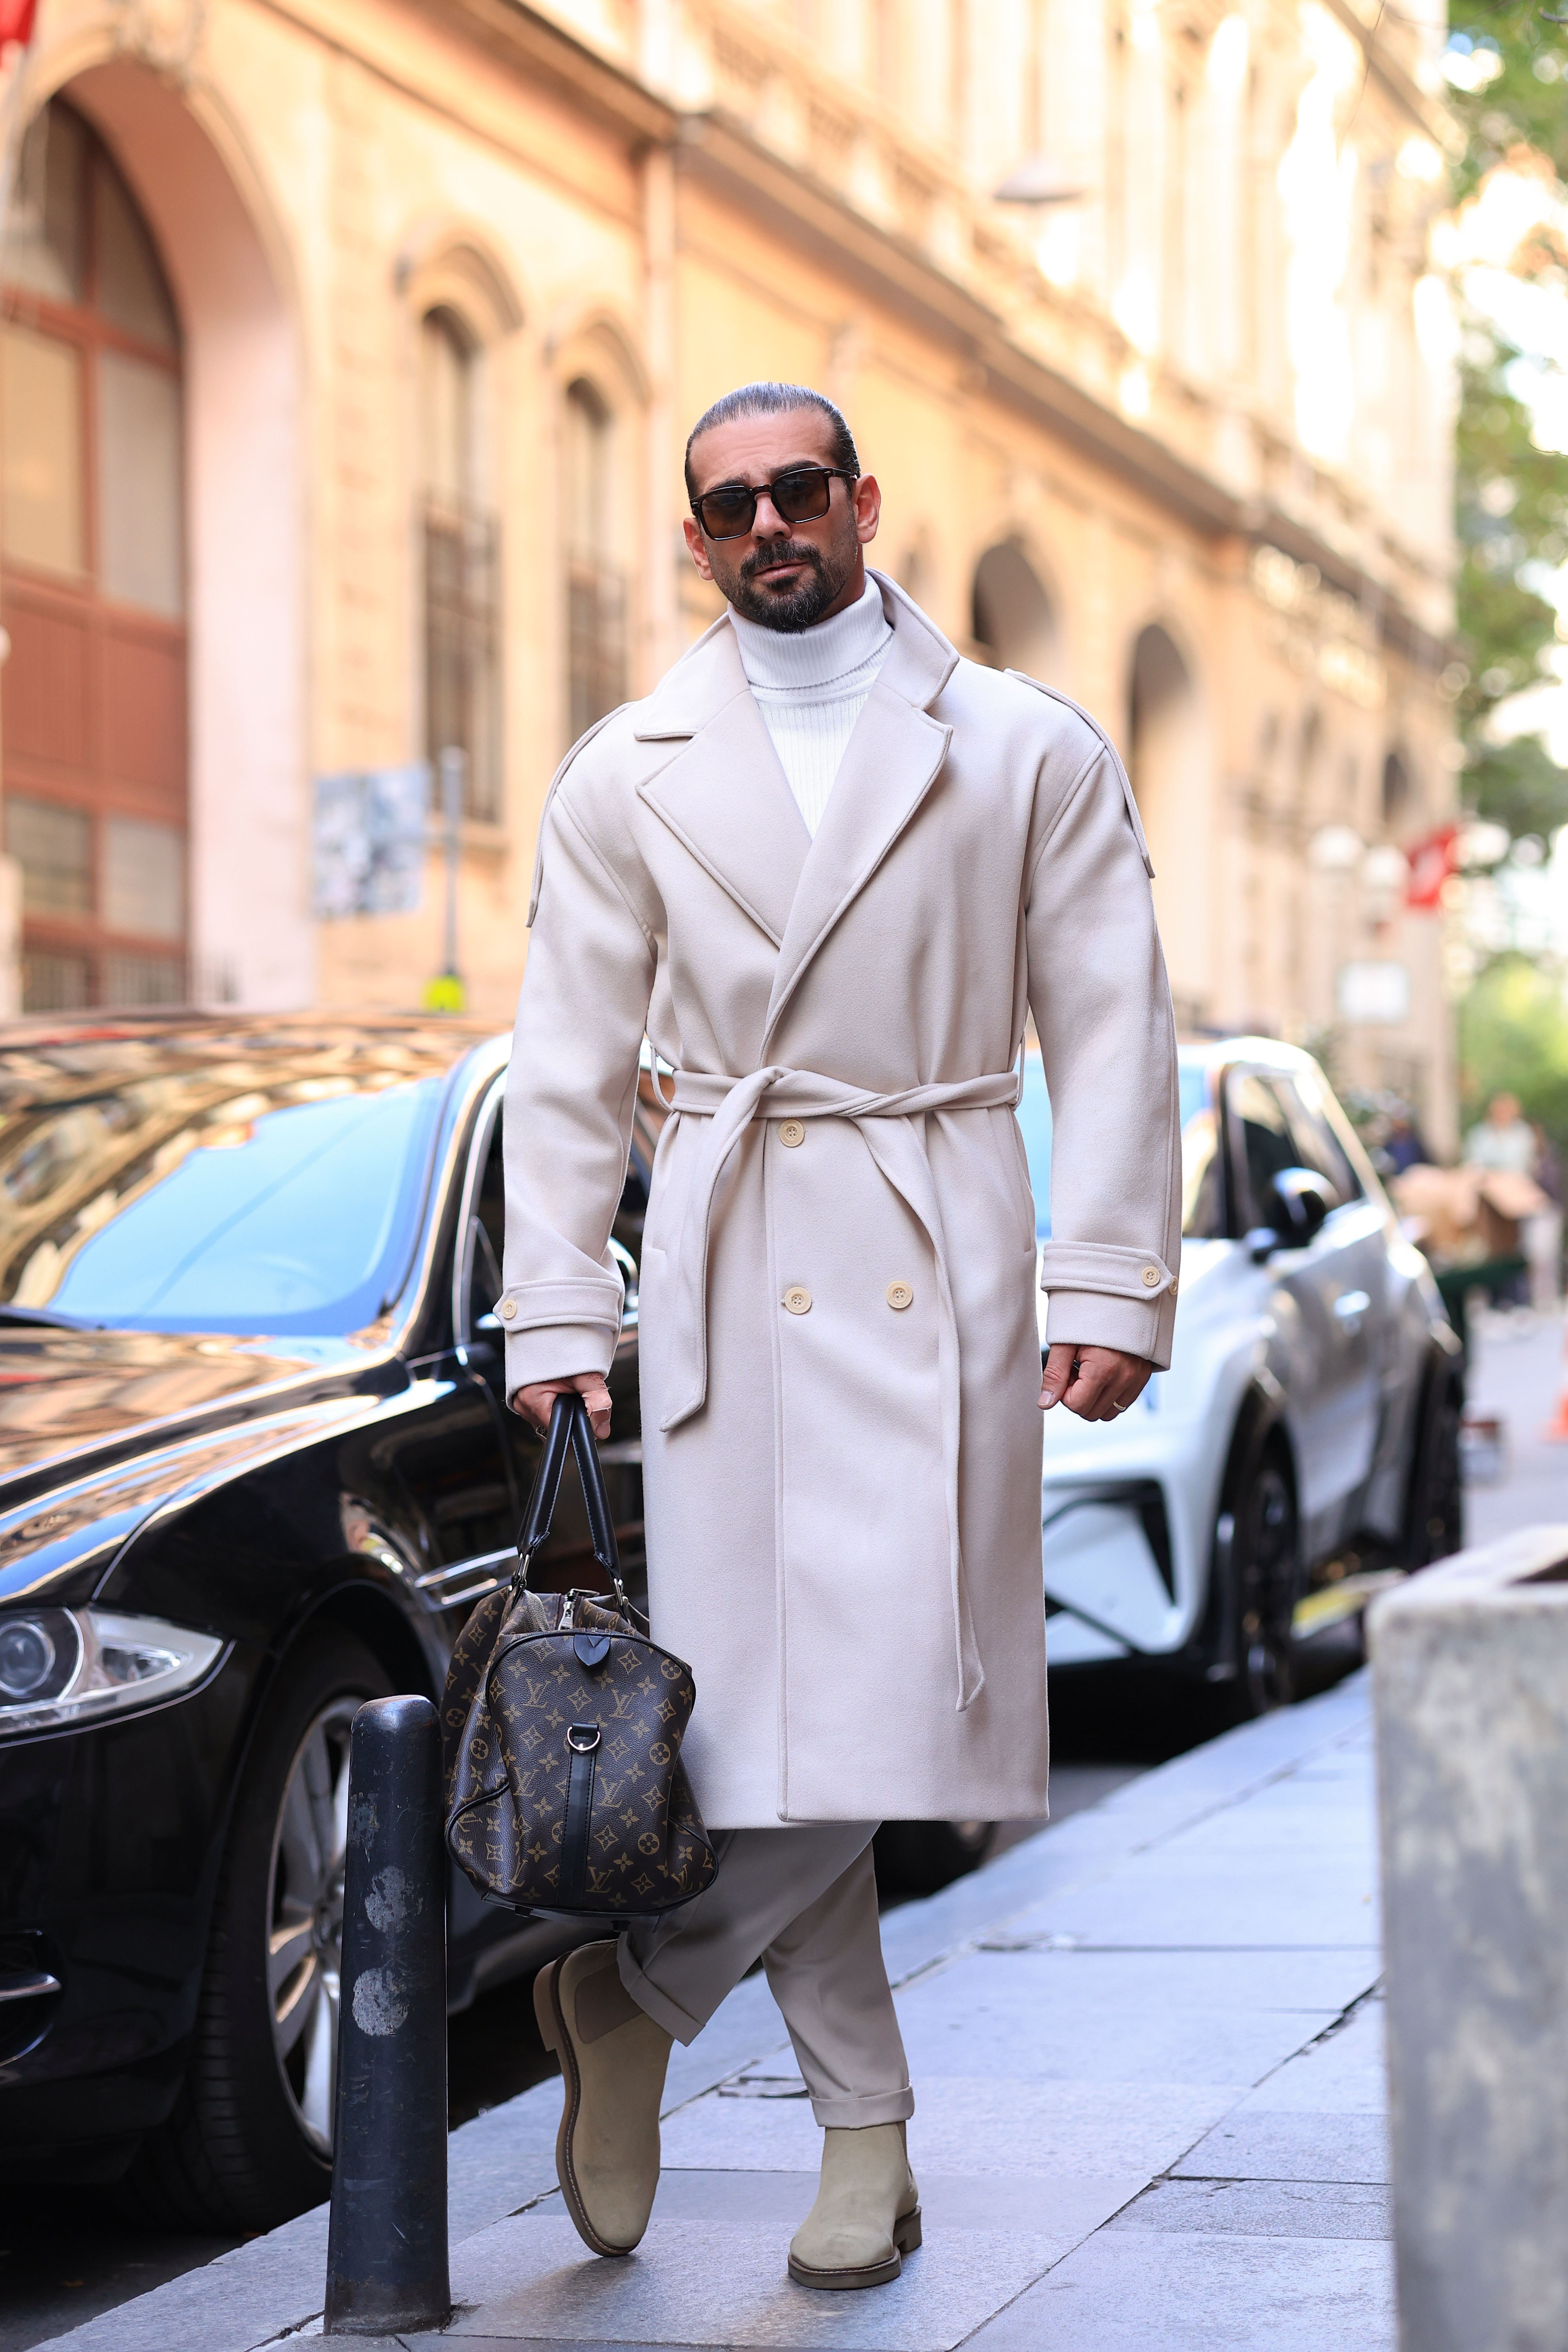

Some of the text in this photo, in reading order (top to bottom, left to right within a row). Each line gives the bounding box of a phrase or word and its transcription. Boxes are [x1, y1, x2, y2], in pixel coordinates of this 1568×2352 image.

[609, 1689, 639, 1719] LV
[597, 1778, 626, 1808] LV
[586, 1866, 614, 1893] LV
